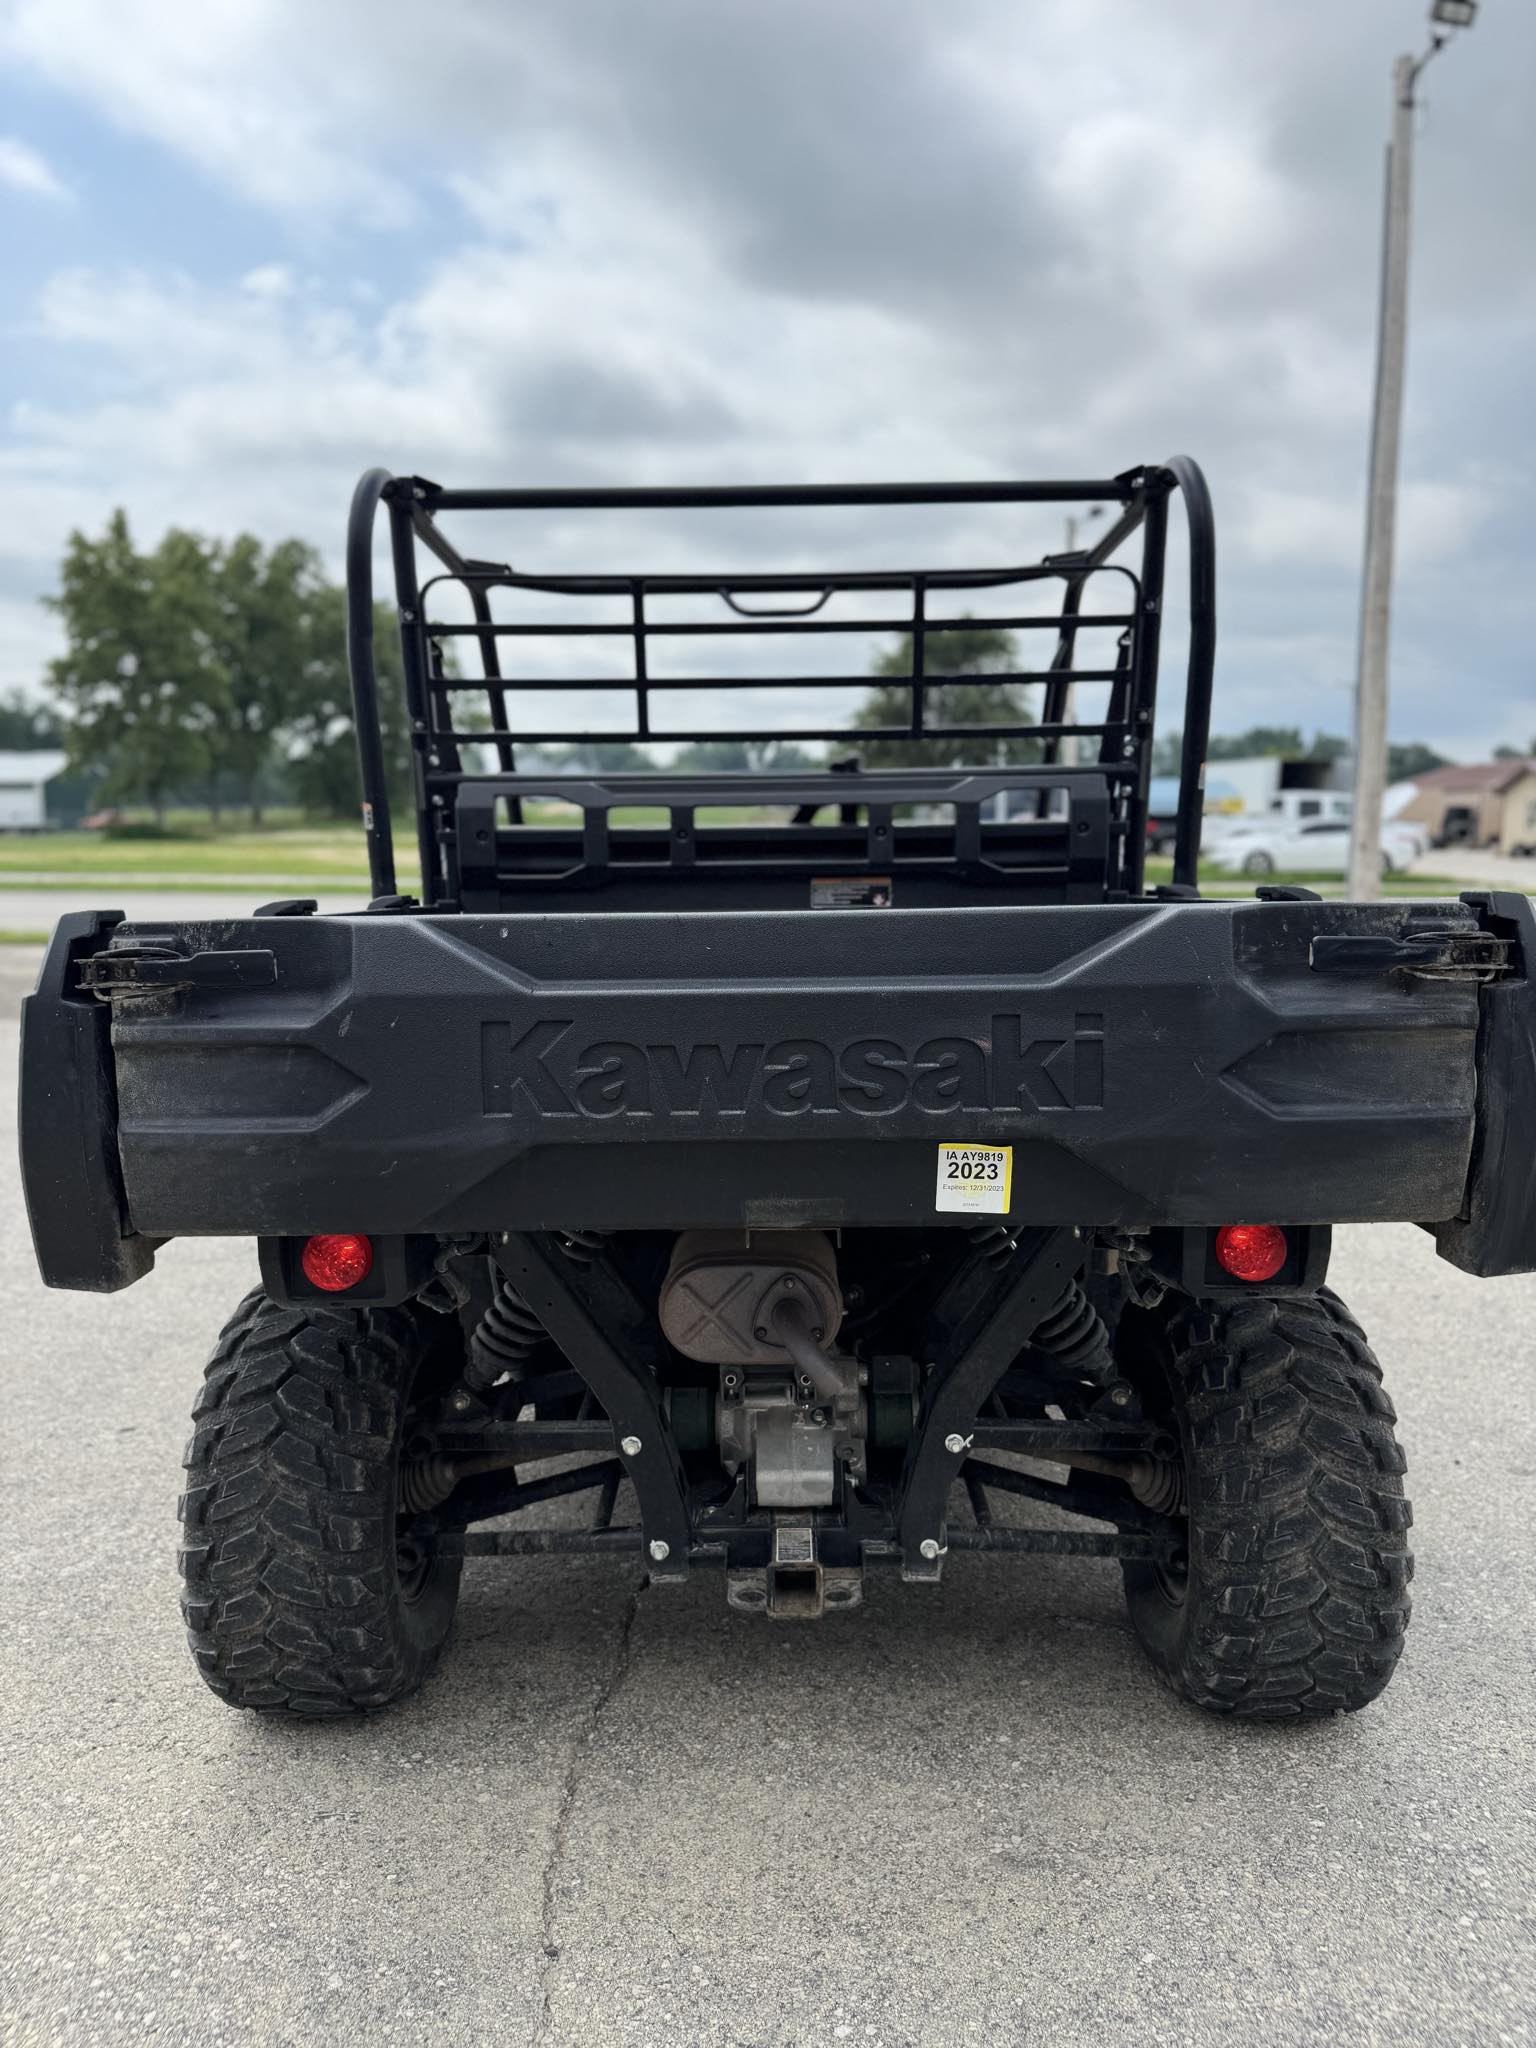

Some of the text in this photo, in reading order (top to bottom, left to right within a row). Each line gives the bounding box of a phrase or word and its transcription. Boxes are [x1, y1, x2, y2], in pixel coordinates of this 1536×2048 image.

[480, 1013, 1104, 1117] Kawasaki
[946, 1151, 1004, 1162] IA AY9819
[947, 1162, 999, 1180] 2023
